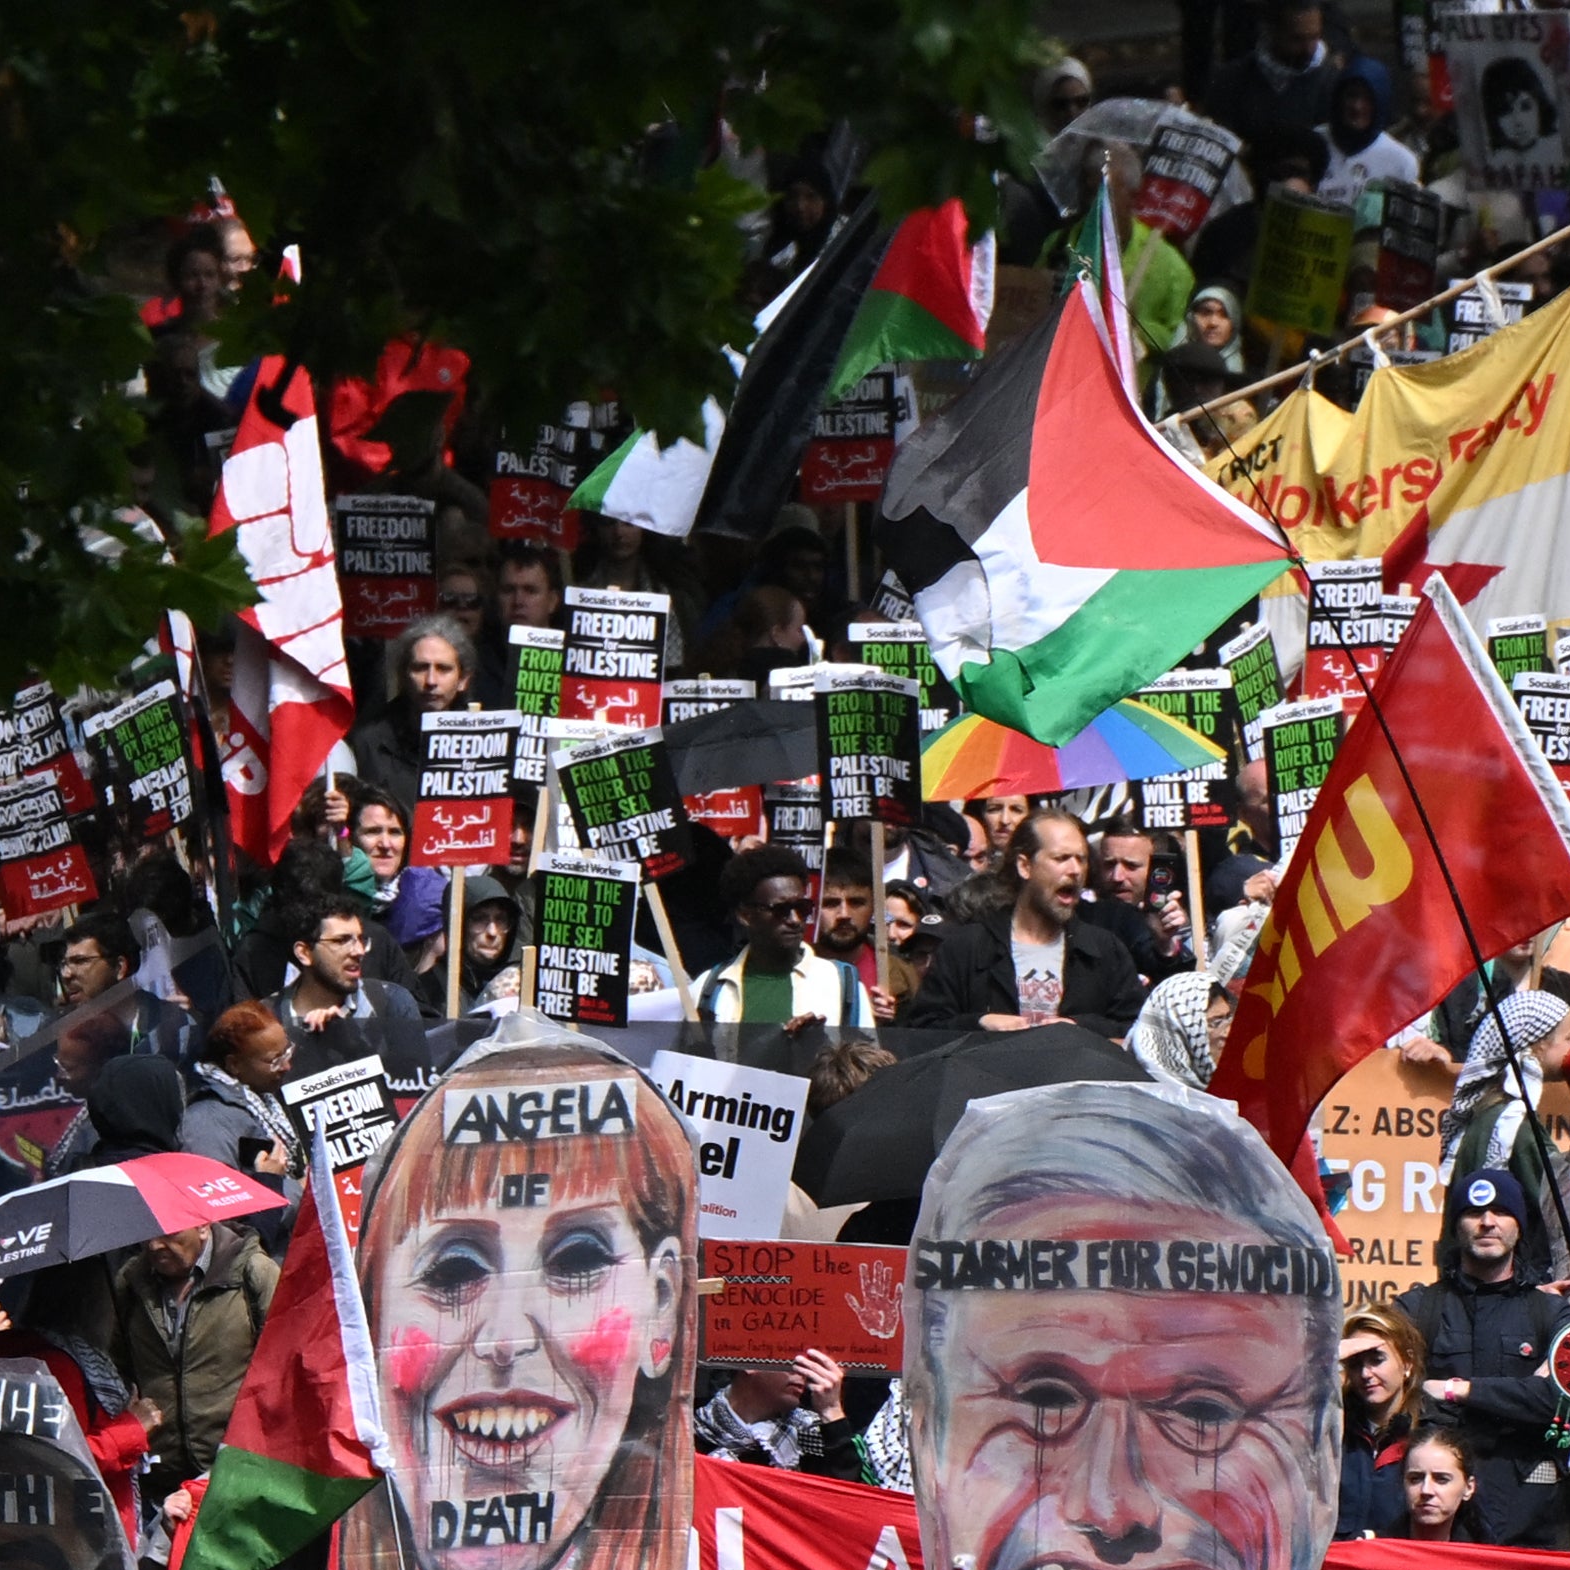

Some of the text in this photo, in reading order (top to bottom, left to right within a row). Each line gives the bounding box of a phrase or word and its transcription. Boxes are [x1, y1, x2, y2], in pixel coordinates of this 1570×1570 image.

[572, 611, 656, 640] FREEDOM
[567, 650, 657, 679] PALESTINE
[428, 733, 509, 759] FREEDOM
[1273, 717, 1337, 749] FROM THE
[830, 755, 911, 781] PALESTINE
[1275, 740, 1334, 771] RIVER TO
[421, 770, 508, 796] PALESTINE
[1142, 782, 1210, 806] WILL BE
[832, 797, 872, 818] FREE
[545, 875, 623, 906] FROM THE
[544, 899, 613, 927] RIVER TO
[543, 922, 604, 950] THE SEA
[540, 944, 620, 976] PALESTINE
[539, 968, 599, 996] WILL BE
[537, 991, 574, 1018] FREE
[446, 1081, 634, 1143] ANGELA
[714, 1245, 852, 1275] STOP the
[916, 1239, 1333, 1297] STARMER FOR GENOCID
[711, 1287, 825, 1307] GENOCIDE
[433, 1493, 555, 1548] DEATH
